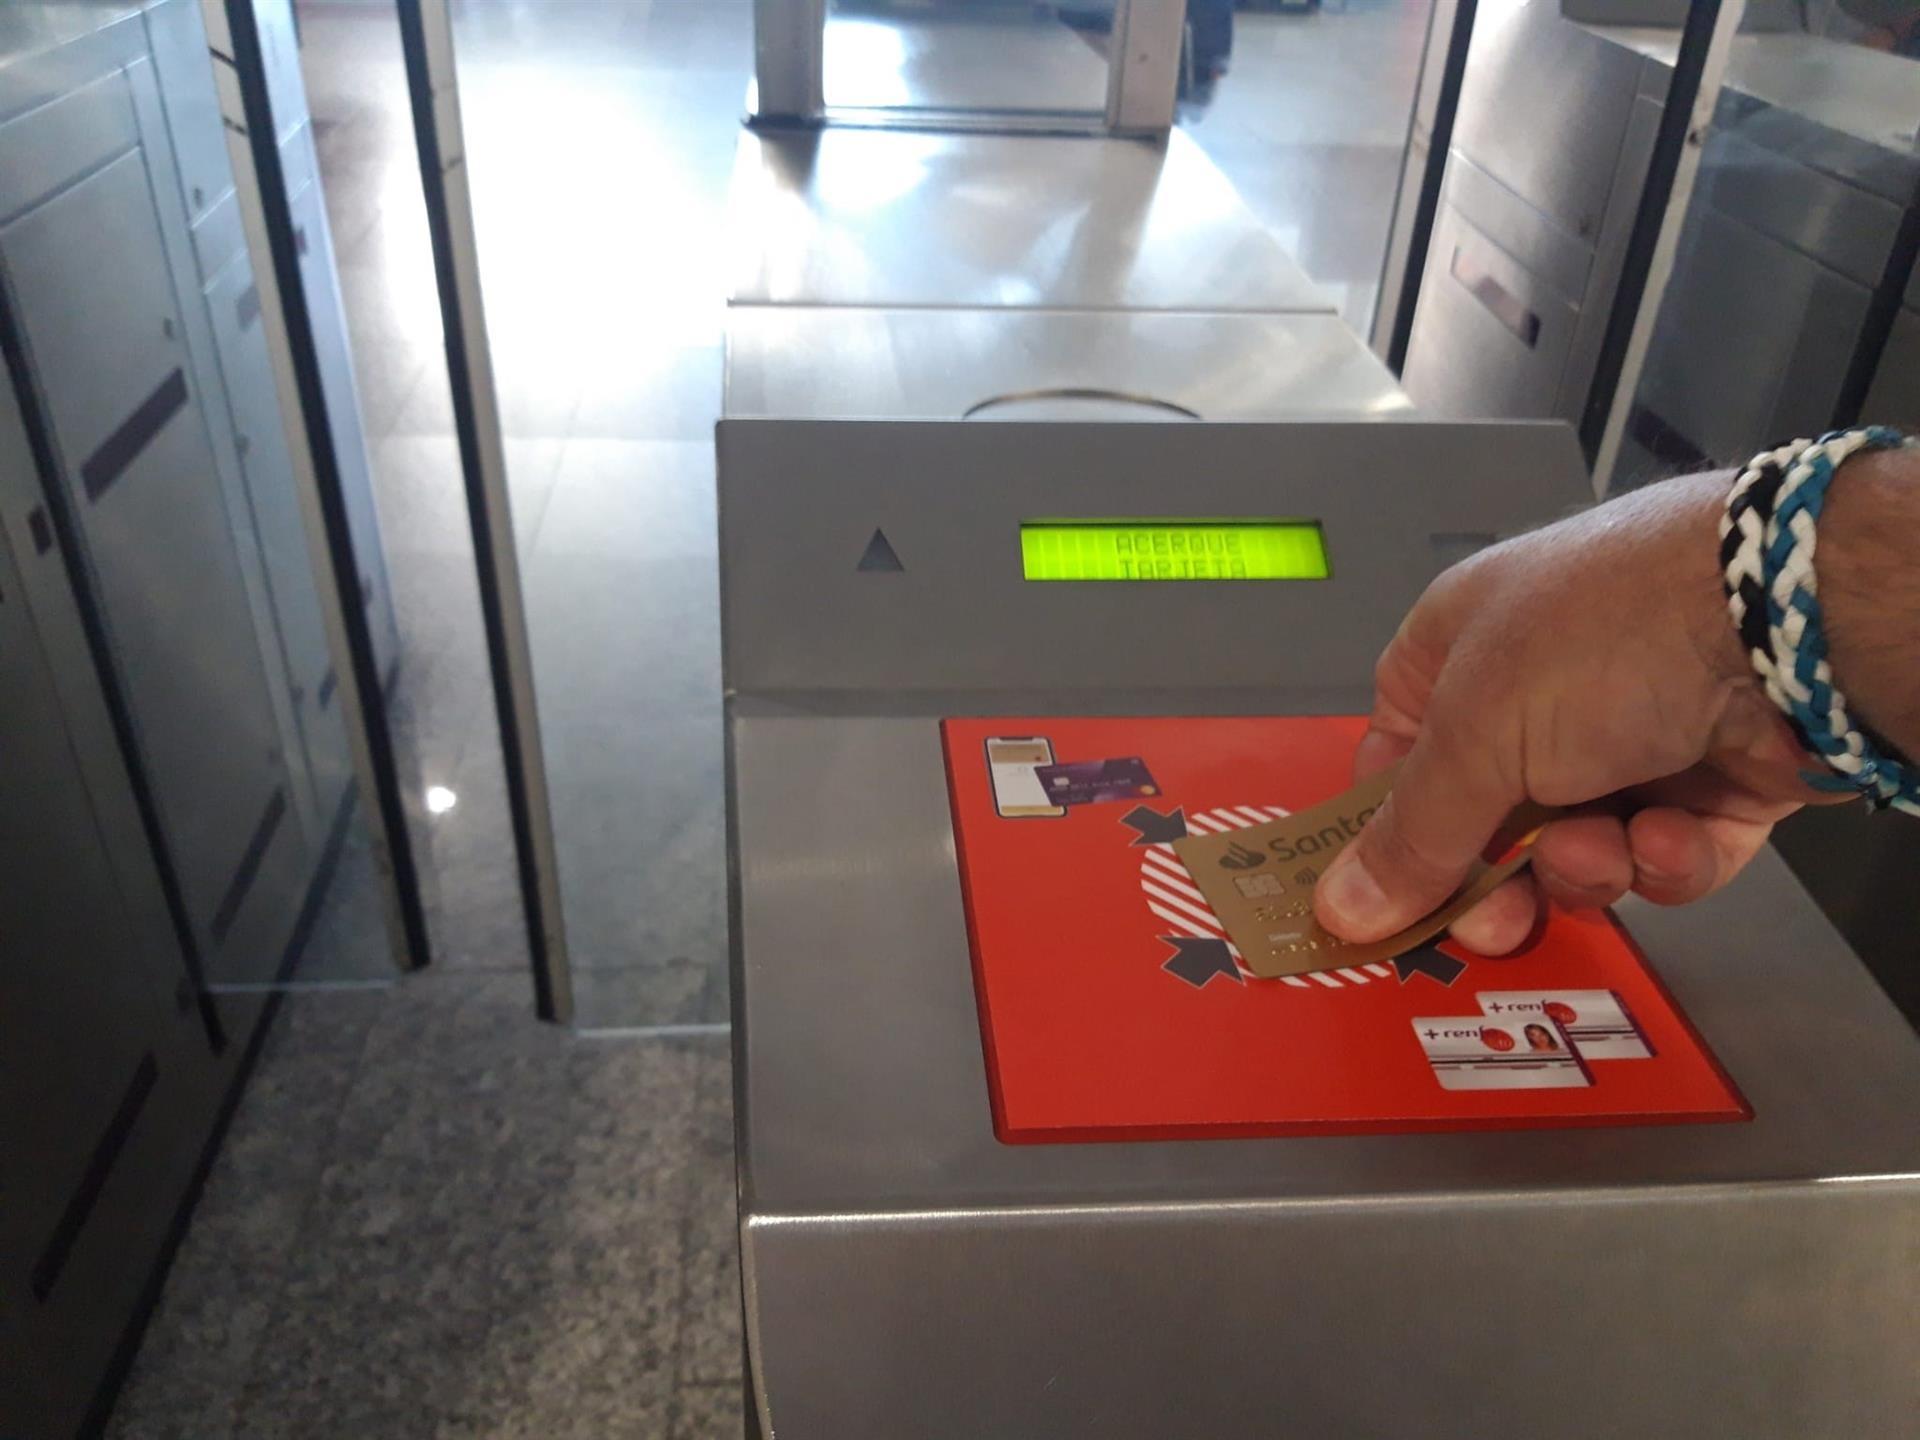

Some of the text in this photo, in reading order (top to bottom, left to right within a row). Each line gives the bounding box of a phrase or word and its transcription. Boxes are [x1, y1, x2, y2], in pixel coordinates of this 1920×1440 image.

[1115, 532, 1243, 555] ACERQUE
[1119, 558, 1247, 579] TARJETA
[1268, 799, 1384, 863] Santa
